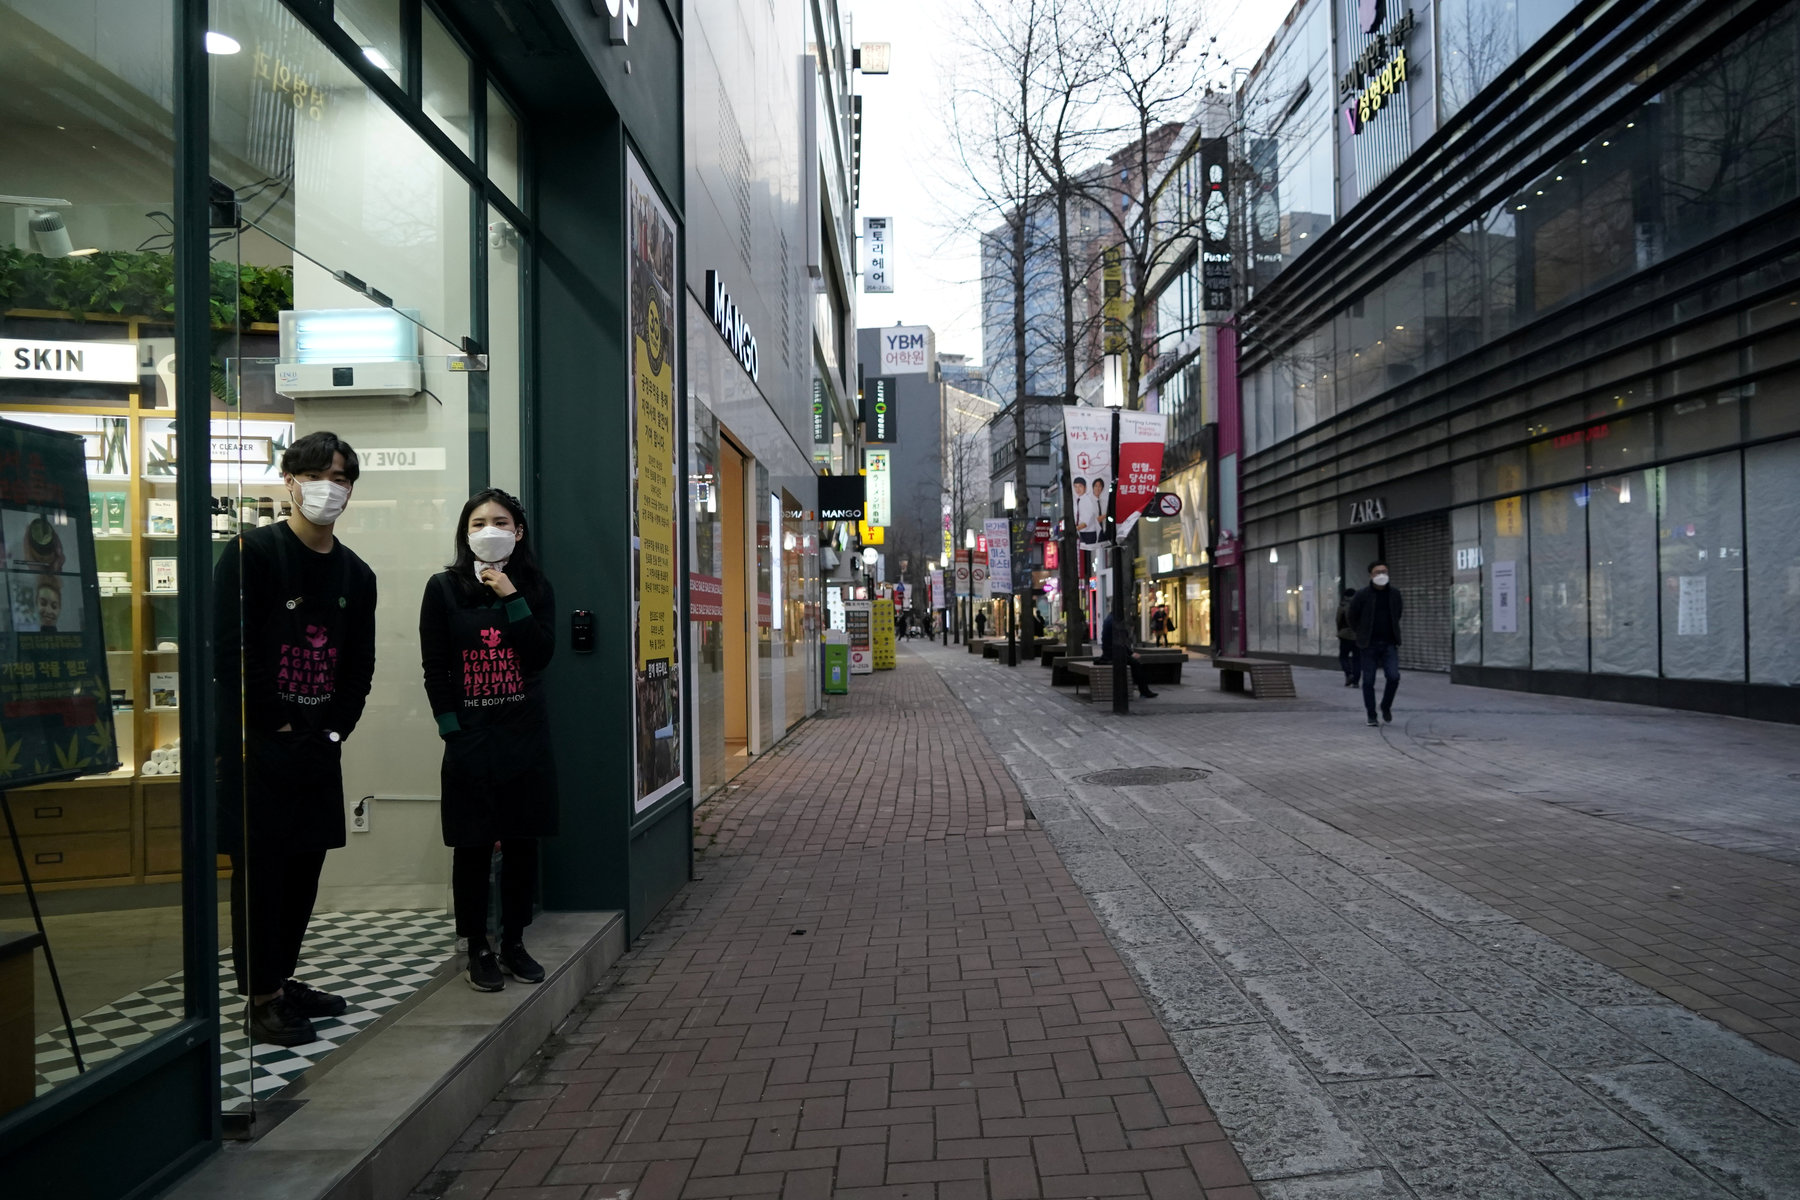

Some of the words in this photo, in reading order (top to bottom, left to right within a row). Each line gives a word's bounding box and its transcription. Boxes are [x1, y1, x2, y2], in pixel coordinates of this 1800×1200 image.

[872, 231, 884, 283] 토리헤어
[713, 269, 759, 383] MANGO
[887, 334, 924, 350] YBM
[14, 347, 84, 372] SKIN
[886, 350, 925, 366] 어학원
[877, 380, 885, 402] OLIVE
[877, 413, 885, 439] YOUNG
[1128, 473, 1156, 483] 당신이
[822, 509, 862, 518] MANGO
[1350, 498, 1385, 525] ZARA
[464, 671, 523, 686] ANIMAL
[464, 699, 480, 708] THE
[481, 697, 505, 707] BODY
